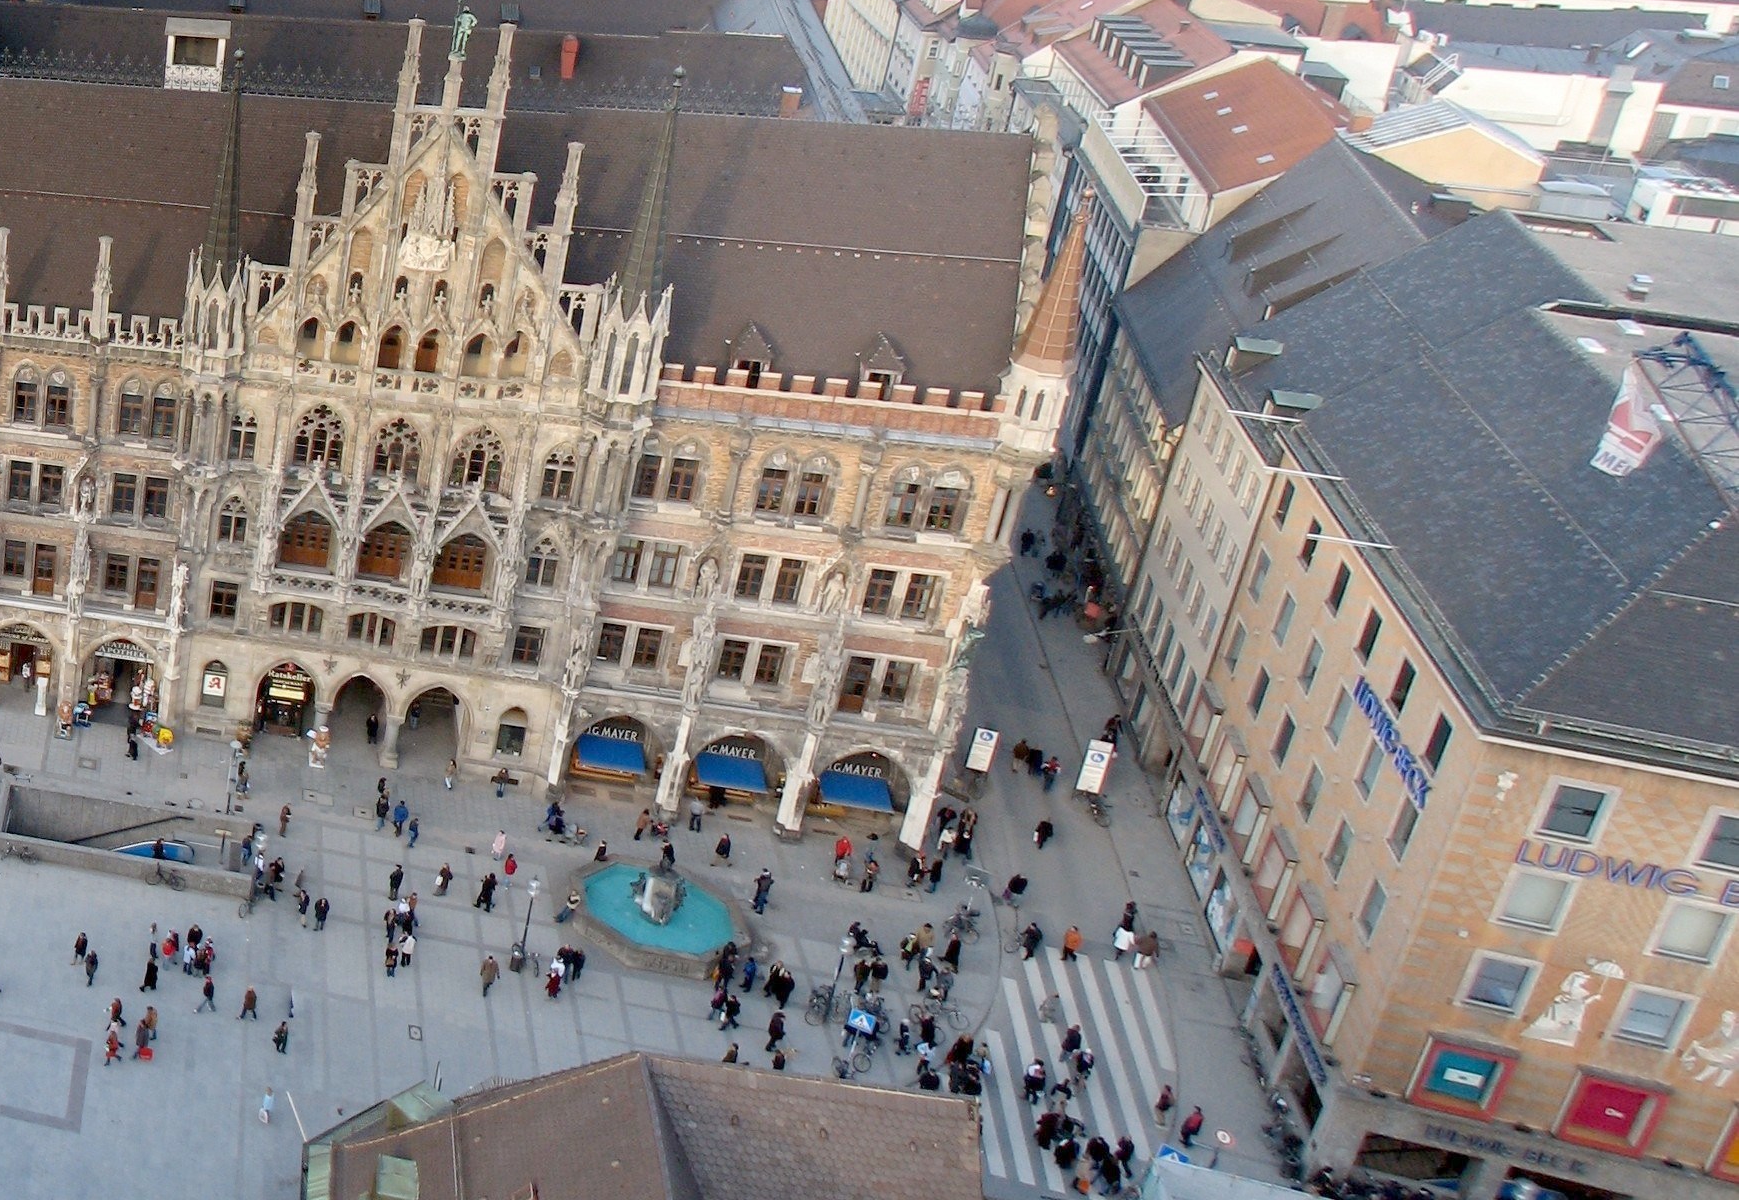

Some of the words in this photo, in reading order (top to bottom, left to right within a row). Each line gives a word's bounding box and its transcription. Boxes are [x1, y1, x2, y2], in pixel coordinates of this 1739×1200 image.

[268, 669, 311, 683] Ratskeller
[602, 726, 638, 742] MAYER
[719, 745, 756, 759] MAYER
[841, 763, 882, 778] MAYER
[1515, 839, 1700, 896] LUDWIG
